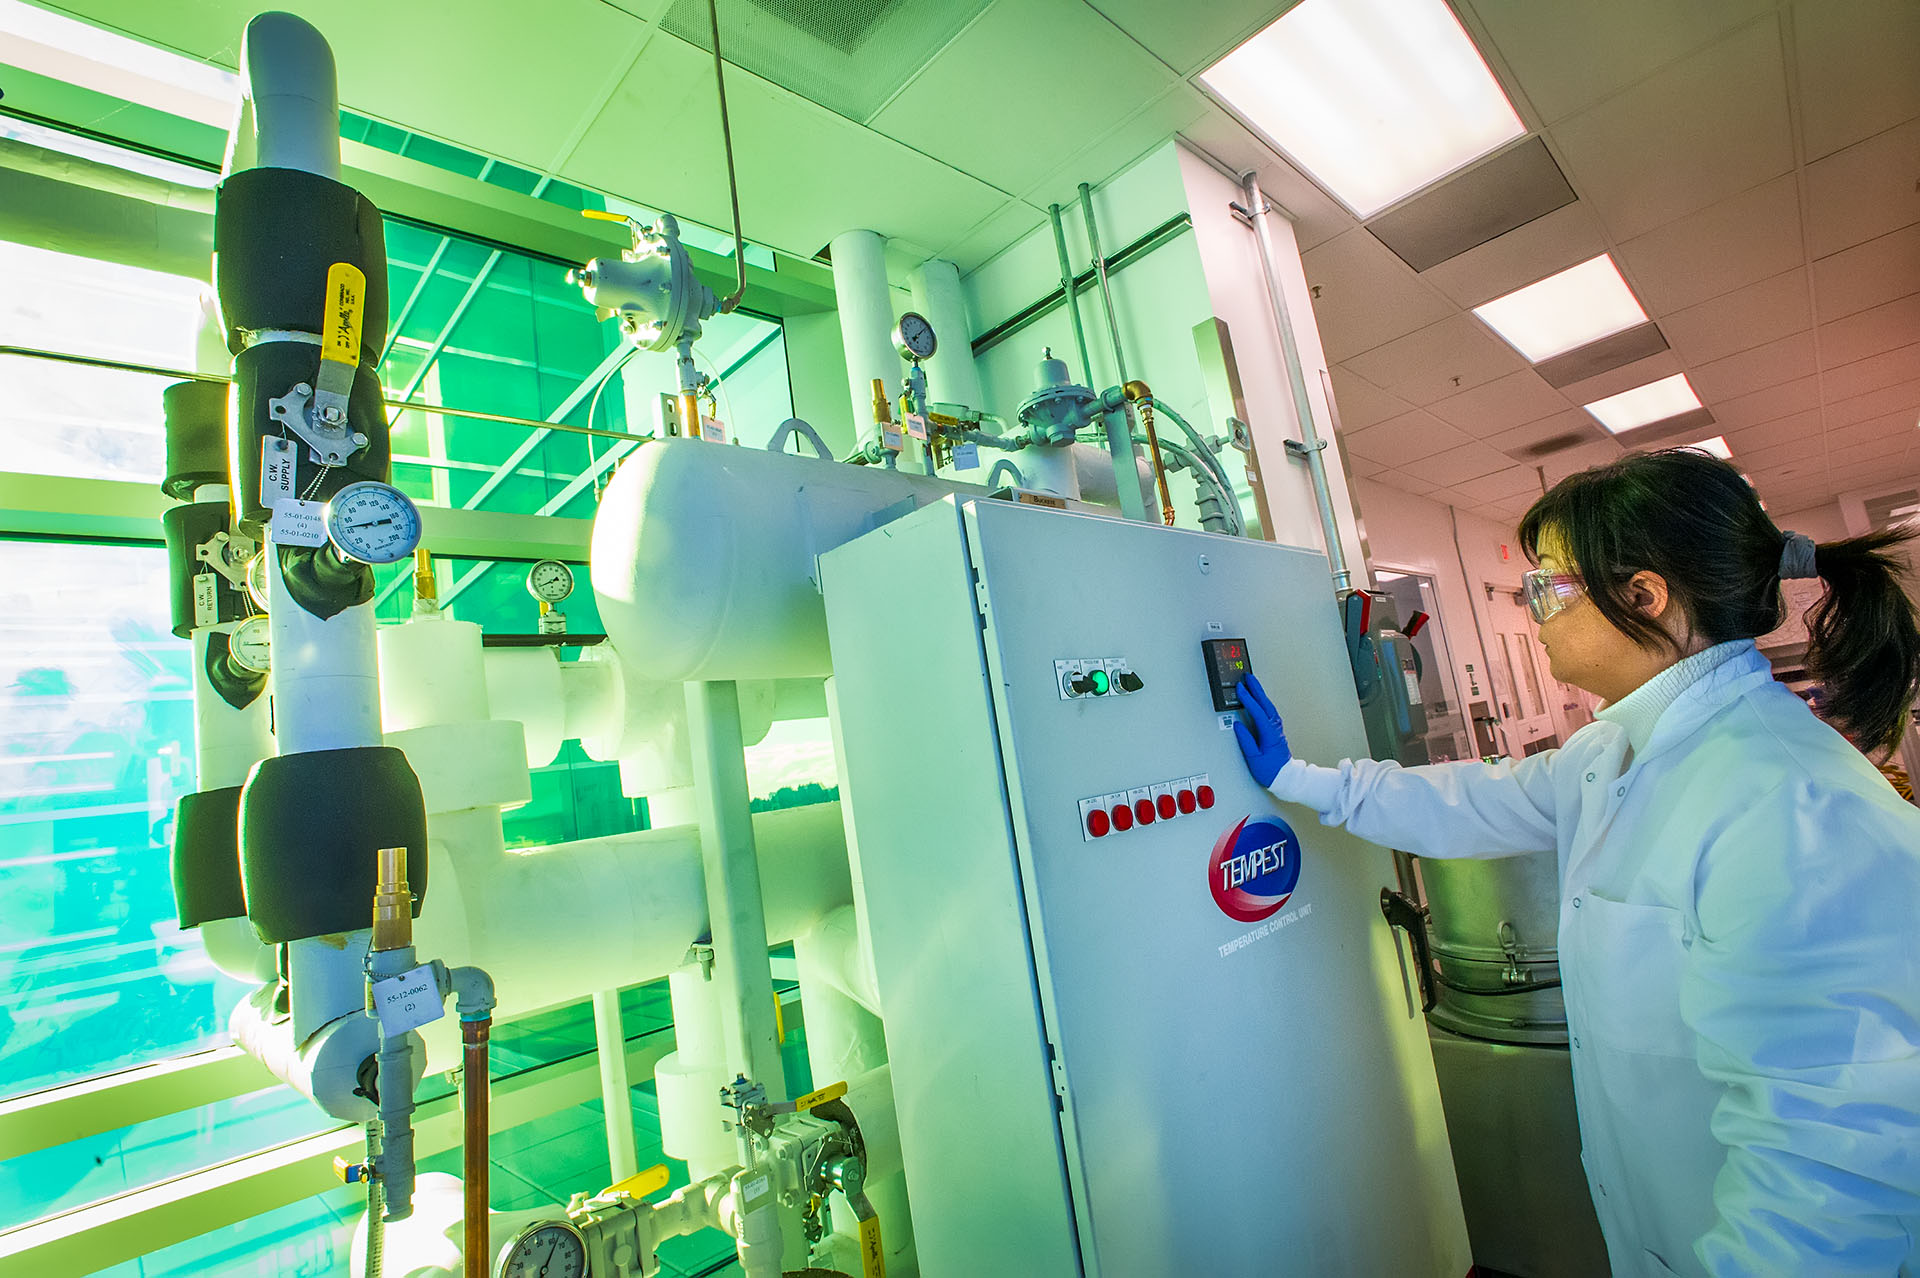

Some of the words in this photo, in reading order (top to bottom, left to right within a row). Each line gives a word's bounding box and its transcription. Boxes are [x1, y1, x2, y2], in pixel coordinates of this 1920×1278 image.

[268, 464, 278, 482] C.W.
[281, 458, 291, 492] SUPPLY
[379, 503, 390, 511] 140
[280, 528, 320, 540] 55-01-0210
[347, 527, 355, 535] 40
[354, 537, 363, 545] 20
[388, 534, 400, 542] 200
[1220, 839, 1288, 892] TEMPEST
[1218, 924, 1270, 959] TEMPERATURE
[1269, 911, 1299, 934] CONTROL
[1298, 903, 1313, 919] UNIT
[386, 983, 429, 1004] 55-12-0062
[404, 1002, 416, 1013] (2)
